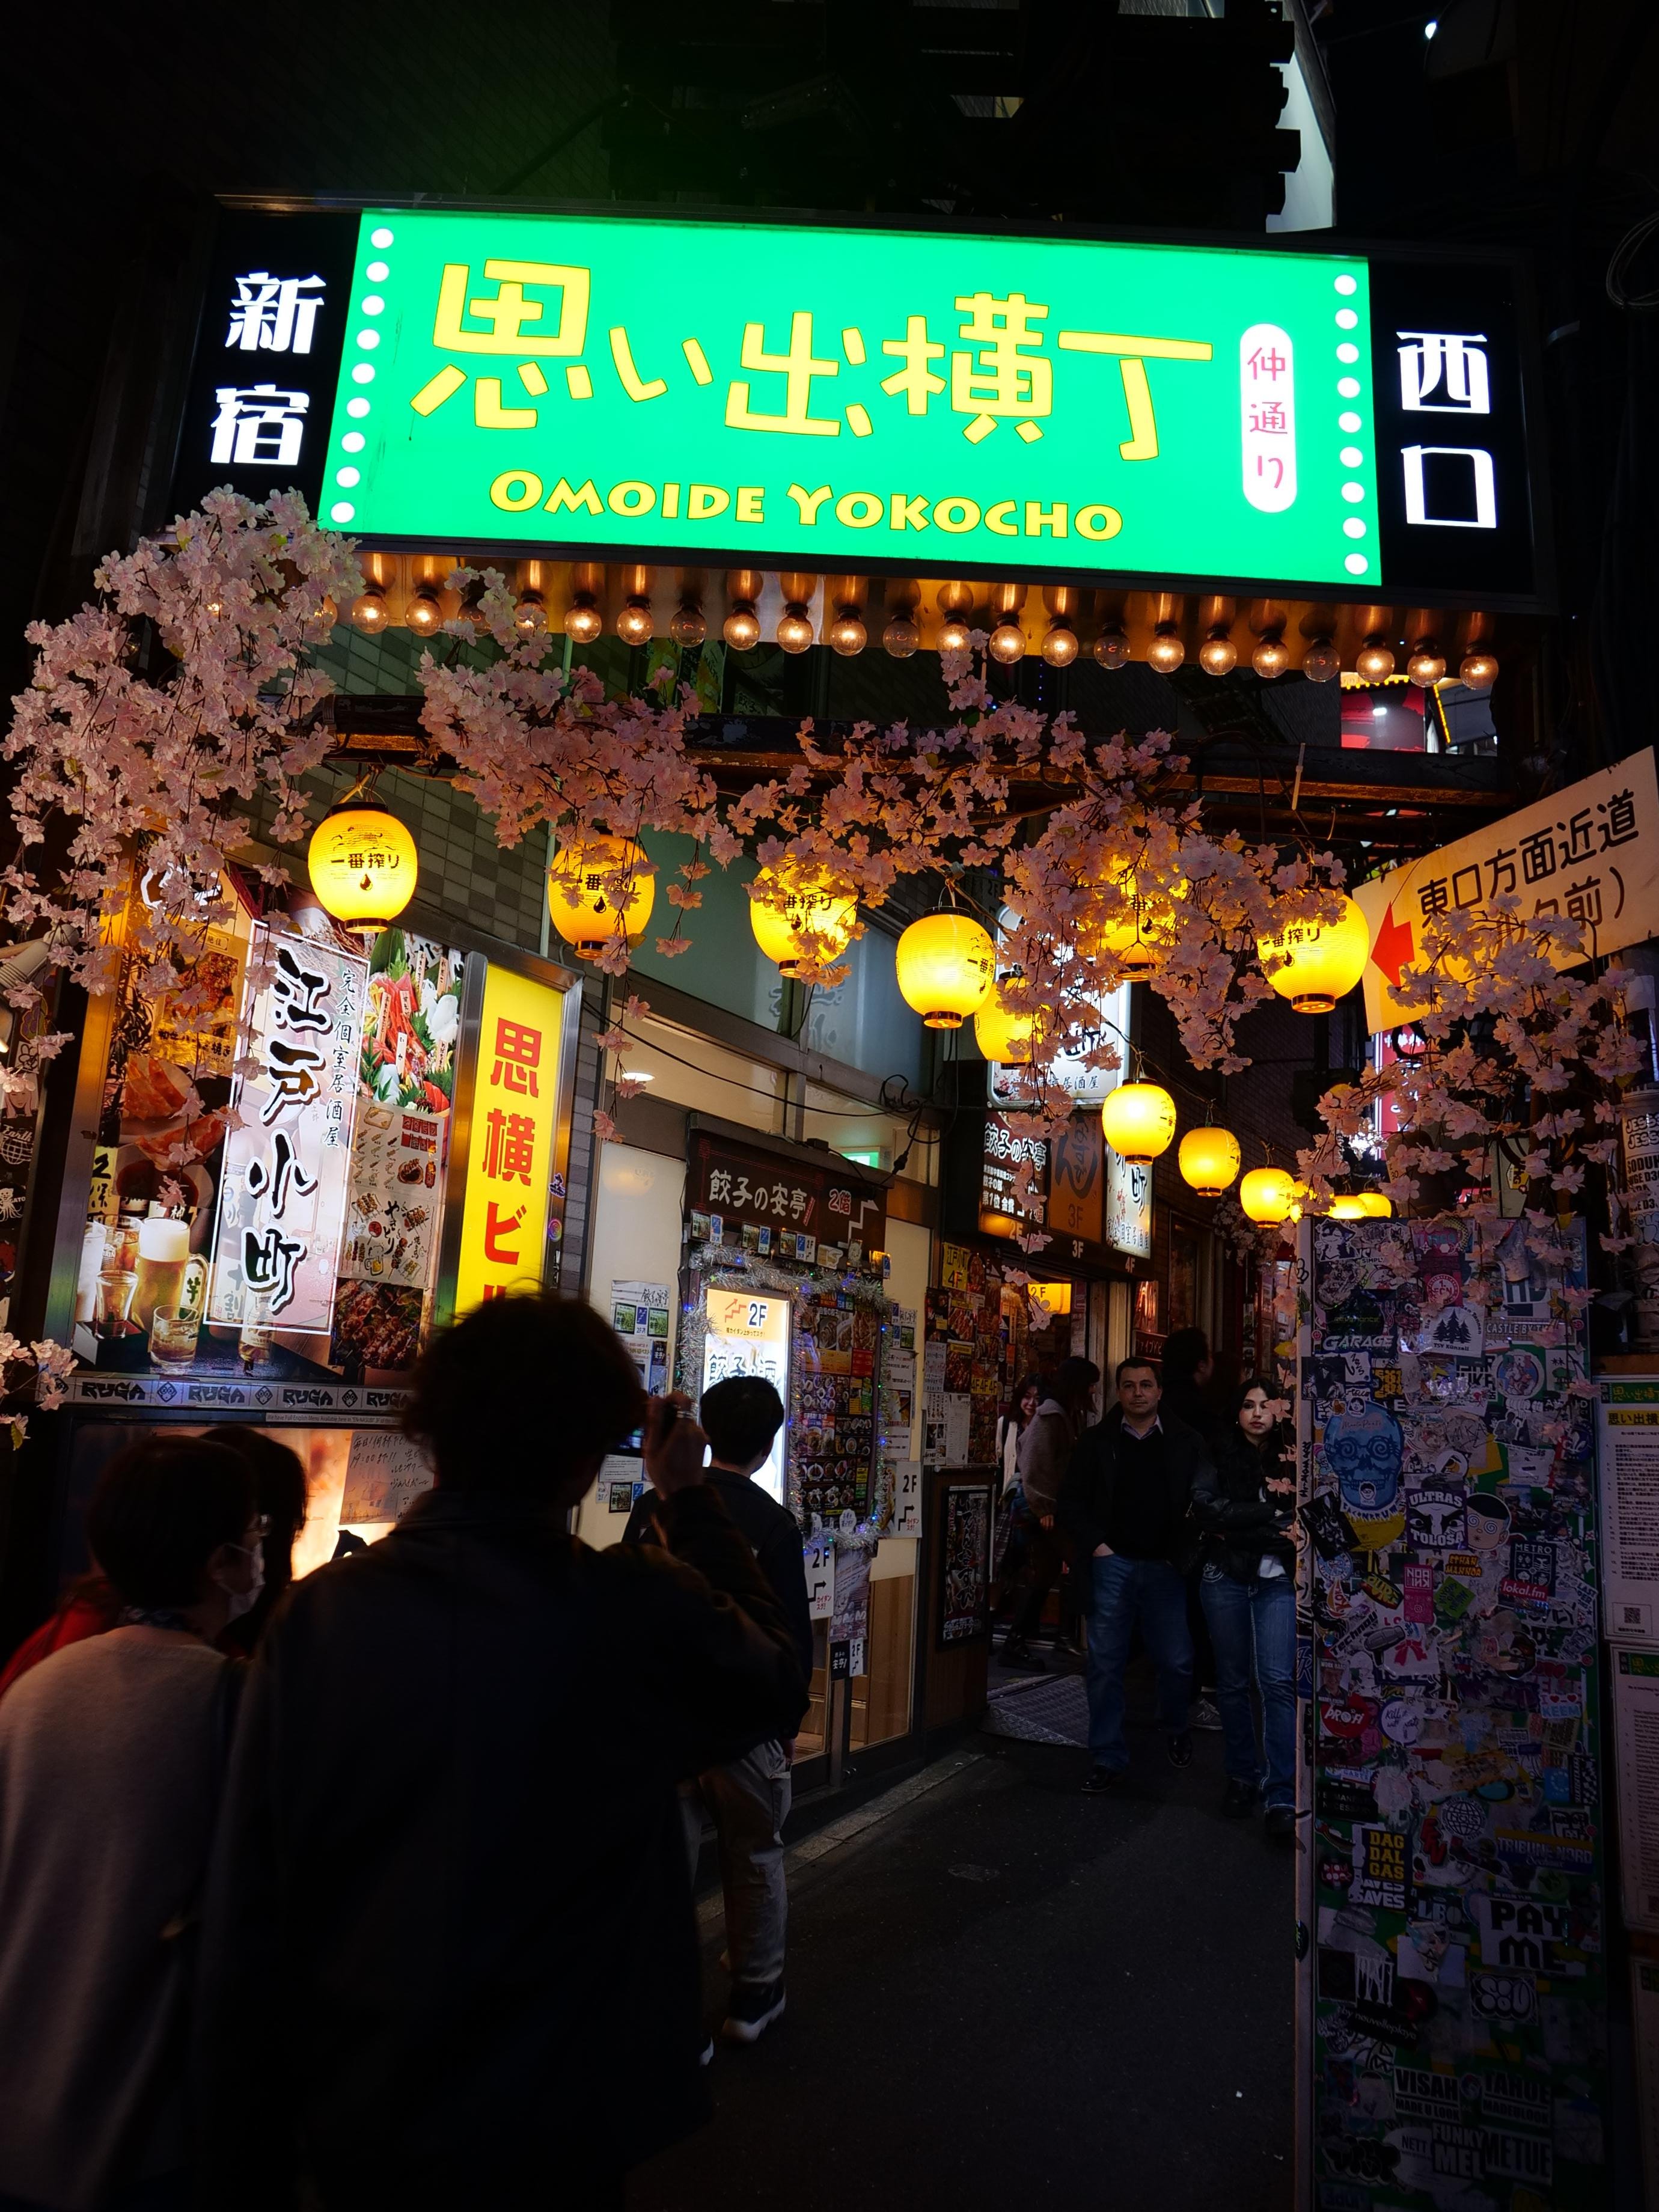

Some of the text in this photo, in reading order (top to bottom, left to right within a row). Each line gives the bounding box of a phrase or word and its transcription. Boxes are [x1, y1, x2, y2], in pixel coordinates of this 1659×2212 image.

[210, 272, 326, 465] 新宿
[409, 259, 1213, 462] 思い出横丁
[1247, 345, 1288, 489] 仲通り
[1396, 331, 1497, 529] 西口
[489, 469, 1123, 542] OMOIDE YOKOCHO
[331, 853, 399, 869] 一番搾り
[1417, 788, 1640, 929] 東口方面近道
[1262, 927, 1321, 948] 一番搾り
[323, 969, 356, 1147] 完全個室居酒屋
[245, 948, 328, 1306] 江戸小町
[709, 1169, 807, 1220] 餃子の安亭
[1068, 1203, 1083, 1230] 3F
[385, 1200, 401, 1256] やきとり
[1072, 1239, 1084, 1259] 3F
[1125, 1256, 1135, 1274] 4F
[187, 1277, 201, 1303] 芋
[749, 1303, 766, 1327] 2F
[1485, 1322, 1520, 1334] CASTLE
[1322, 1334, 1394, 1351] GARAGE
[81, 1382, 146, 1401] RUGA
[188, 1384, 246, 1404] RUGA
[282, 1388, 333, 1406] RUGA
[904, 1474, 917, 1493] 2F
[1409, 1491, 1463, 1508] ULTRAS
[1409, 1529, 1464, 1547] TOLOSA
[813, 1547, 830, 1568] 2F
[1514, 1543, 1553, 1554] METRO
[1502, 1580, 1547, 1599] lokal.fm
[852, 1645, 860, 1658] 2F
[1369, 1830, 1405, 1850] DAG
[1369, 1847, 1405, 1865] DAL
[1369, 1862, 1405, 1881] GAS
[1490, 1899, 1563, 1937] PAY
[1395, 2068, 1458, 2102] VISAH
[1401, 2134, 1428, 2154] NETT
